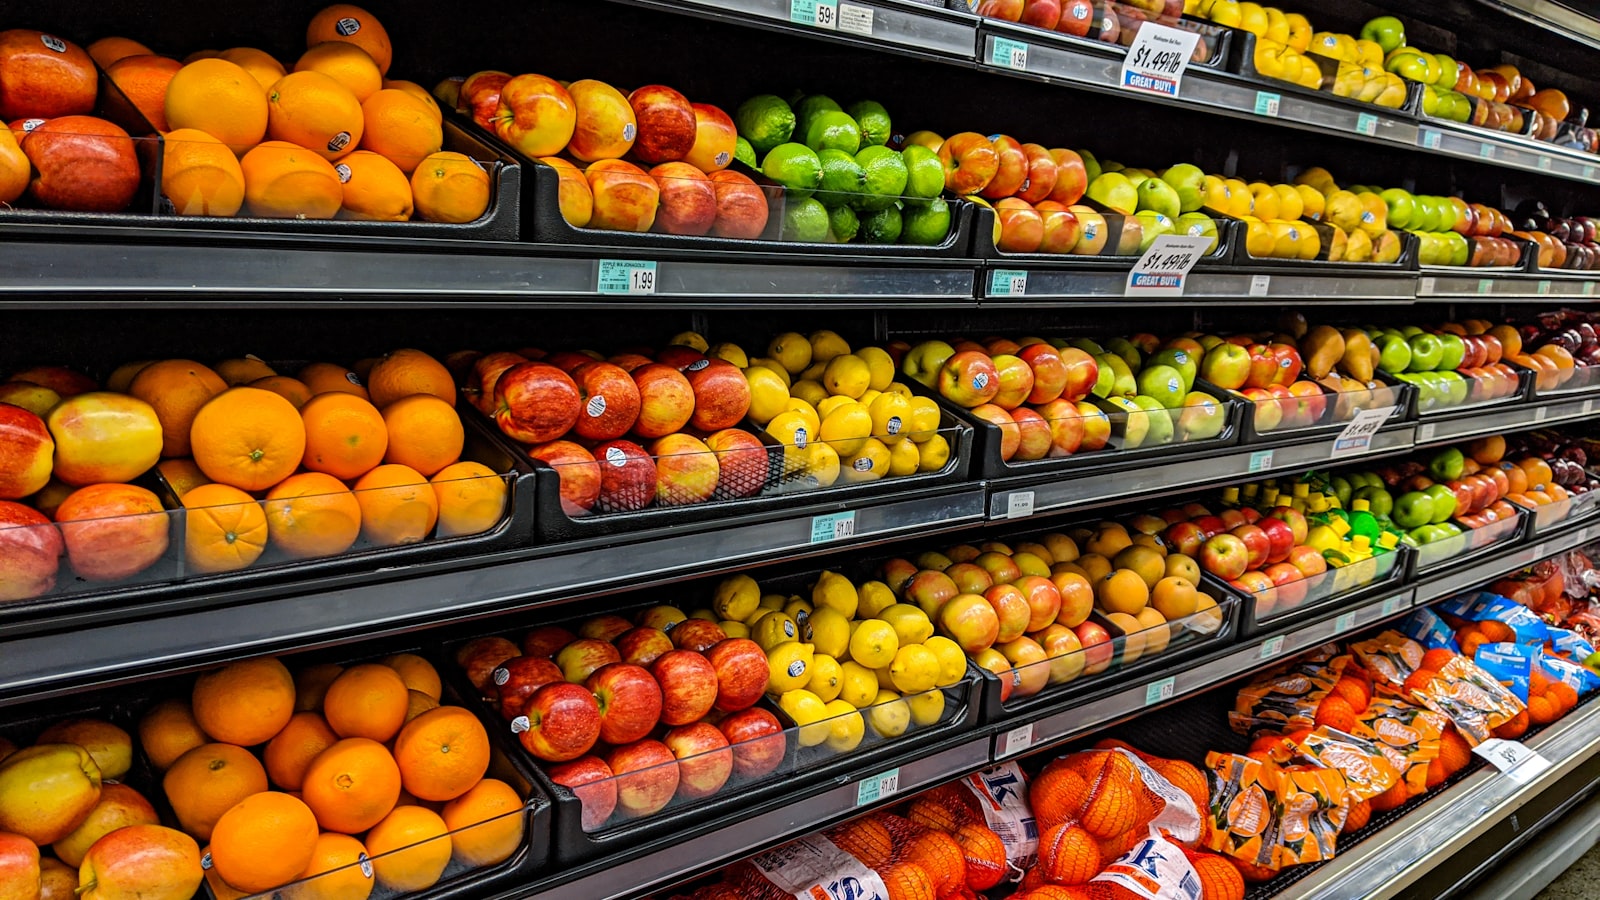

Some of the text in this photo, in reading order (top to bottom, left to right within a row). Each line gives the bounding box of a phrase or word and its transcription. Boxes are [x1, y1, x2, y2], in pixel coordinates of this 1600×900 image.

[819, 6, 834, 24] 59¢
[1013, 51, 1025, 68] 1.99
[1133, 44, 1170, 72] $1.49
[1130, 74, 1154, 89] GREAT
[1154, 78, 1172, 92] BUY!
[1142, 251, 1180, 270] $1.49
[634, 271, 653, 290] 1.99
[1012, 279, 1025, 293] 1.99
[1136, 275, 1178, 286] GREAT BUY!
